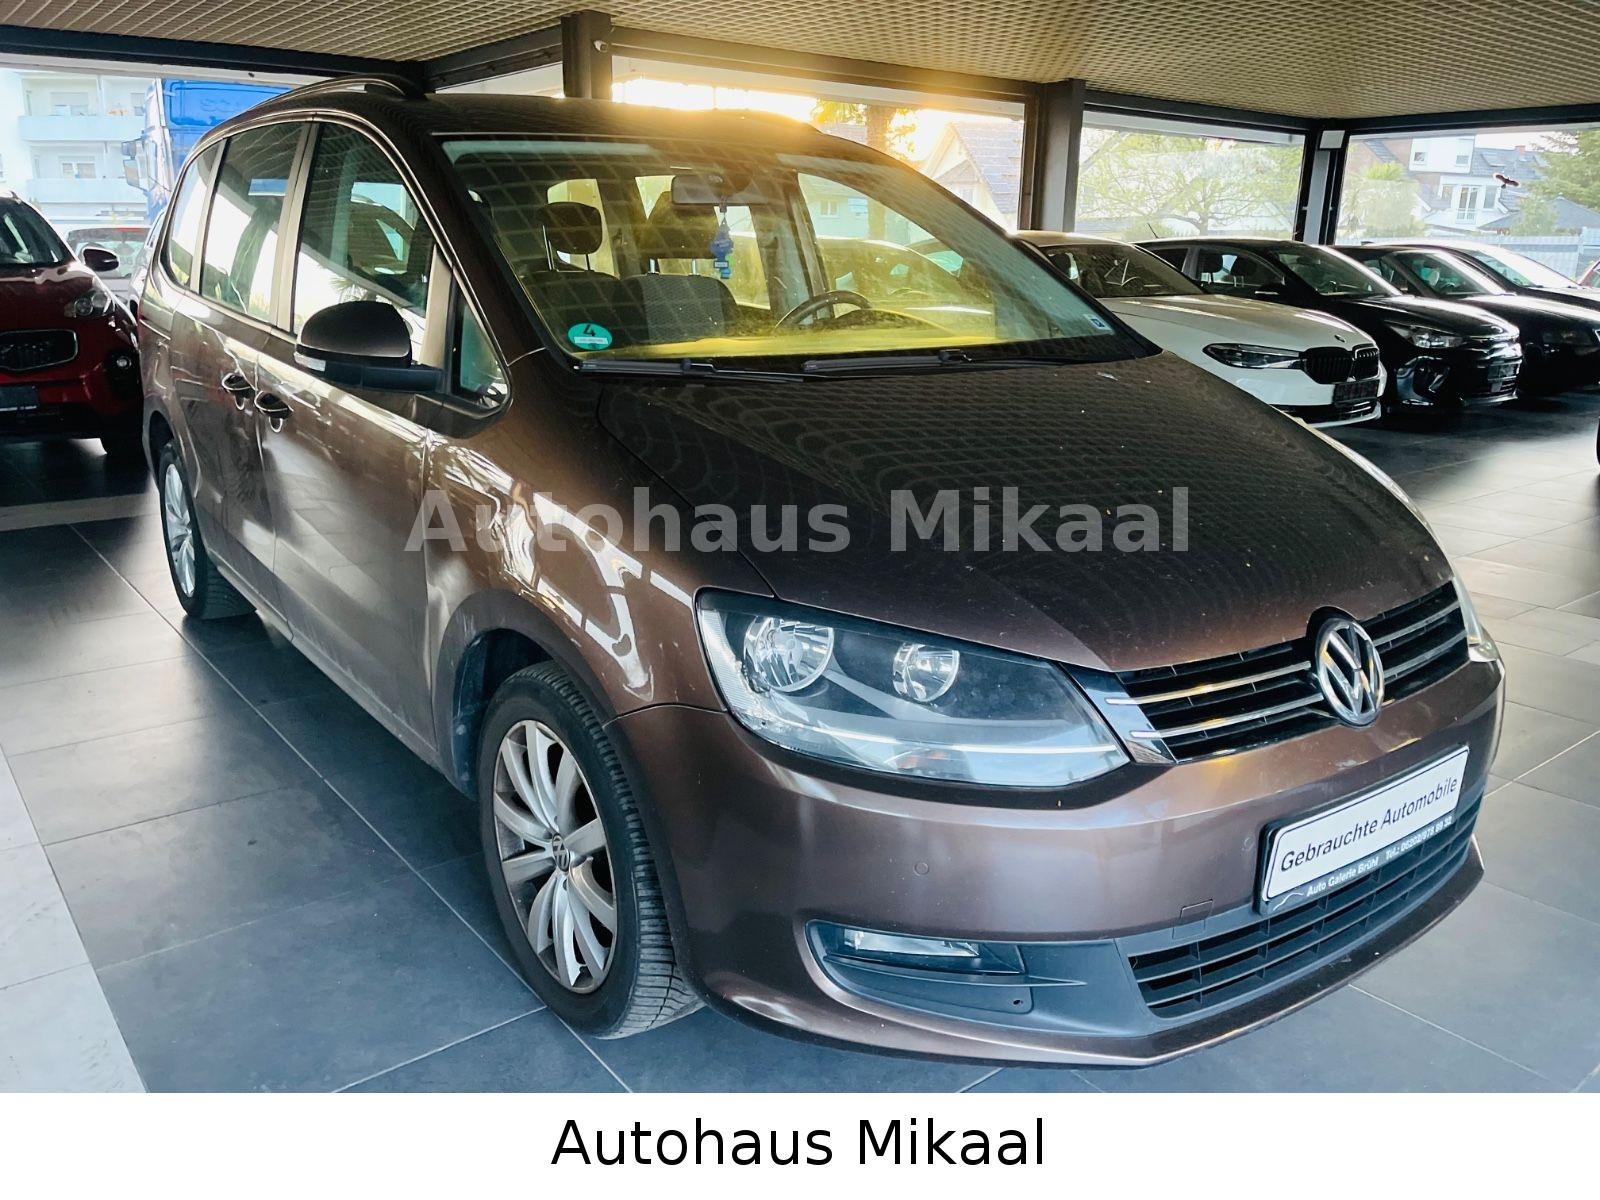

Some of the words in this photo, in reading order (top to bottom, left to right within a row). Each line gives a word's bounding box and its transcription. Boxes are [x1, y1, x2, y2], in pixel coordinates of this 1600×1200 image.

[583, 323, 596, 337] 4
[1281, 820, 1377, 872] Gebrauchte
[1381, 776, 1457, 829] Automobile
[1306, 884, 1327, 897] Auto
[1328, 868, 1357, 887] Galerie
[1357, 856, 1379, 874] Brühl
